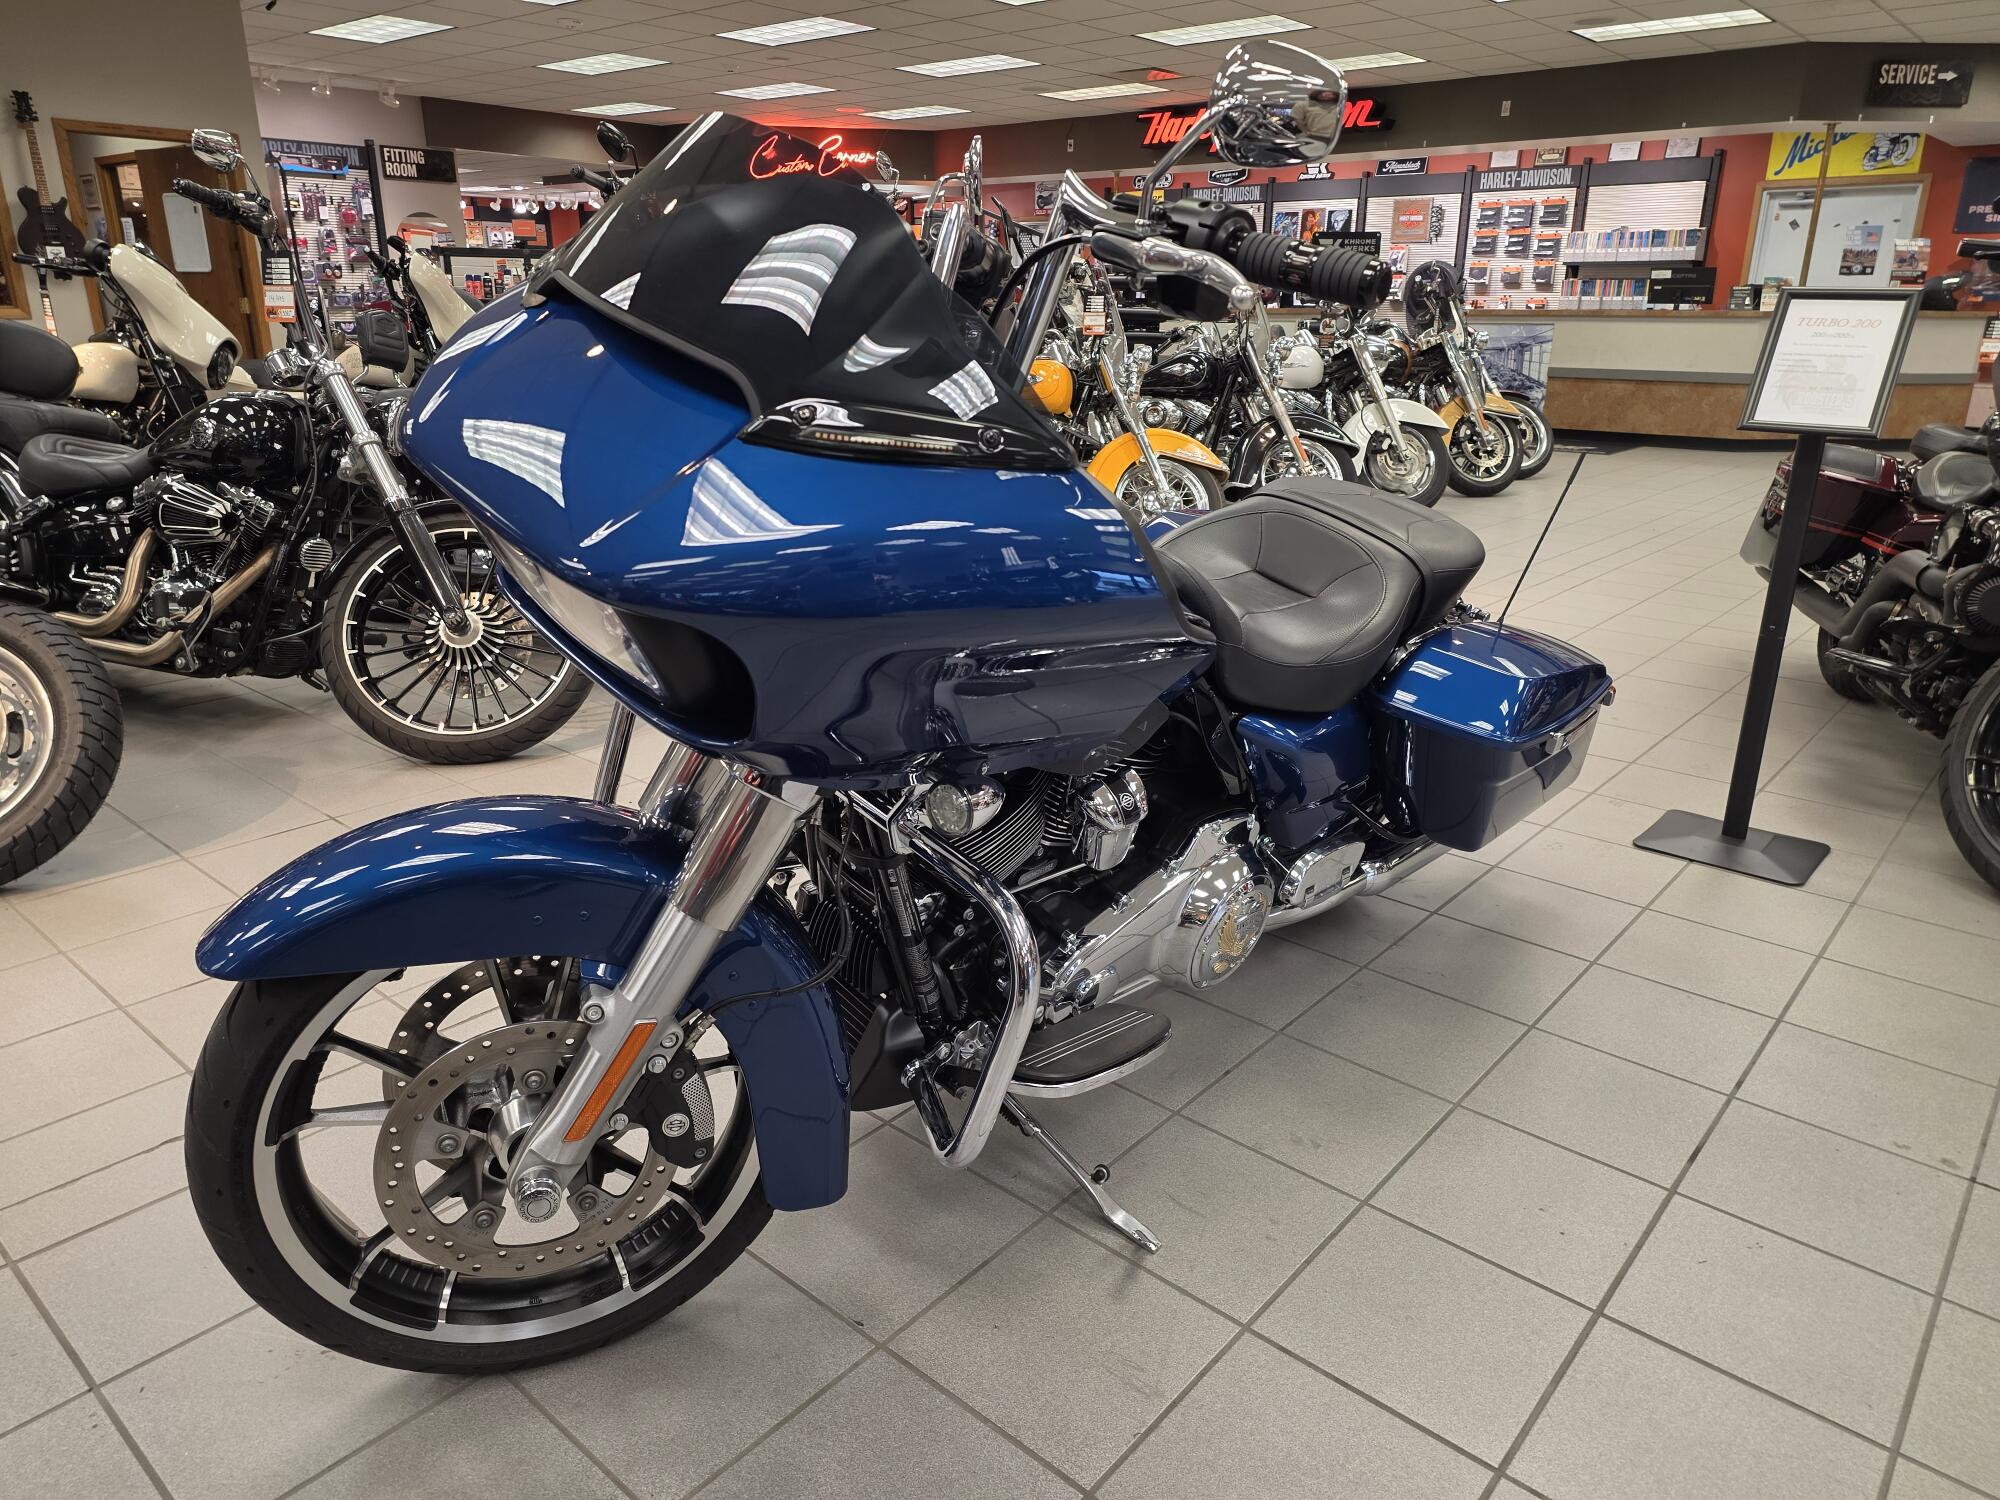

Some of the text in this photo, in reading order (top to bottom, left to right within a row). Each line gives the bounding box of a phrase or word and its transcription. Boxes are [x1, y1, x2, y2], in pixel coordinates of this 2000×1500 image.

[1879, 64, 1938, 85] SERVICE
[383, 147, 426, 165] FITTING
[749, 134, 876, 179] Custom Corner
[385, 162, 418, 178] ROOM
[1480, 167, 1573, 190] HARLEY-DAVIDSON
[1193, 186, 1260, 201] HARLEY-DAVIDSON
[1797, 317, 1850, 328] TURBO
